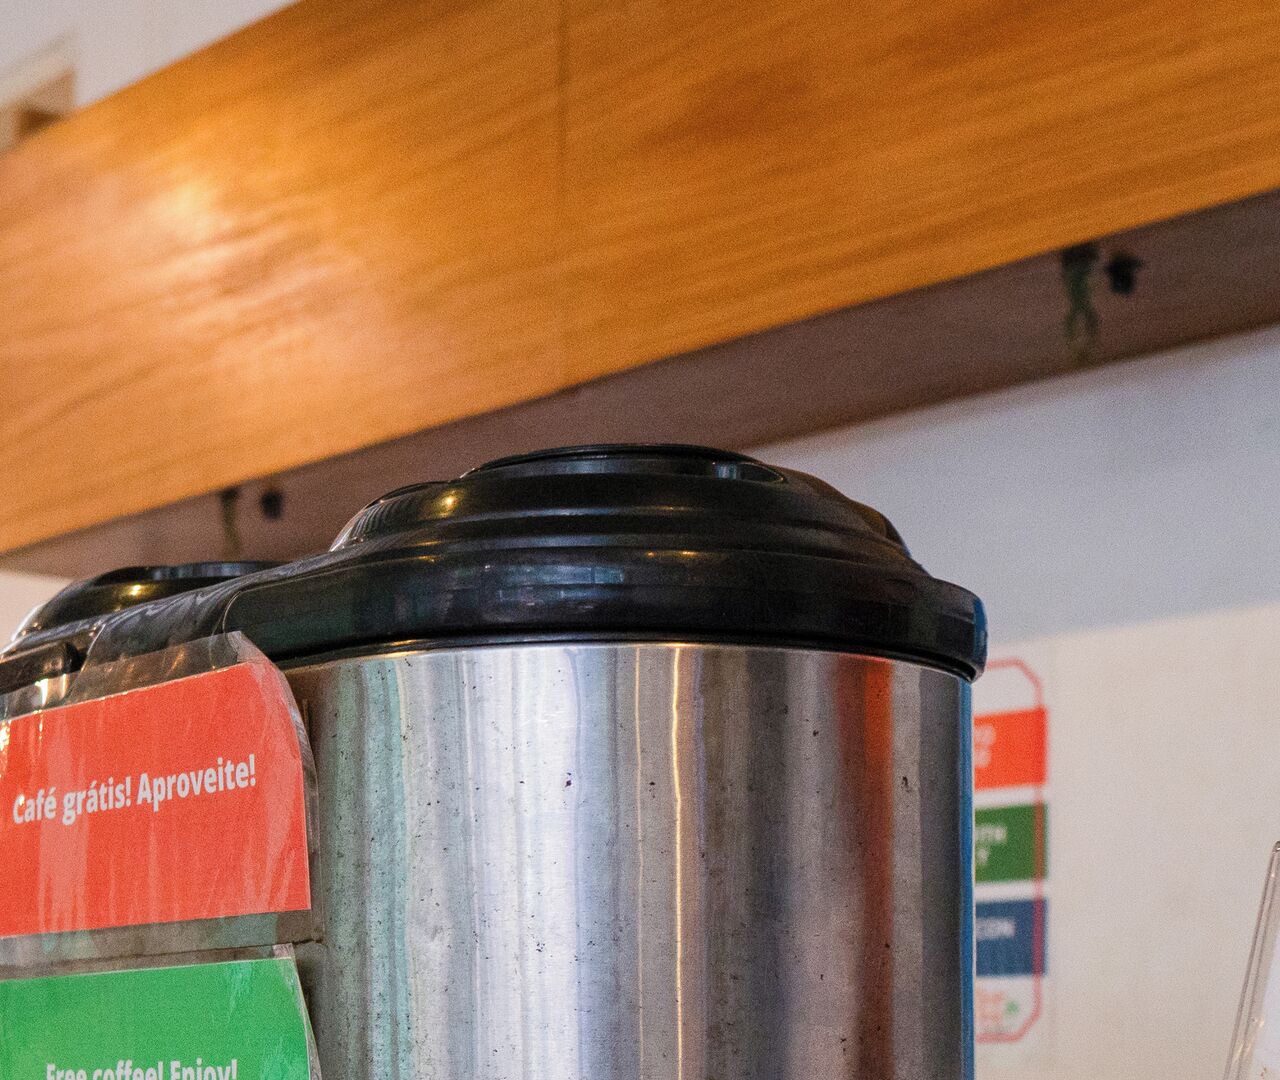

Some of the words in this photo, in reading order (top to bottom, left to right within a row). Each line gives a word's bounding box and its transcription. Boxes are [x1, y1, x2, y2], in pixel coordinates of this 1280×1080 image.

[13, 787, 56, 824] Café
[62, 777, 132, 825] grátis!
[137, 754, 256, 812] Aproveite!
